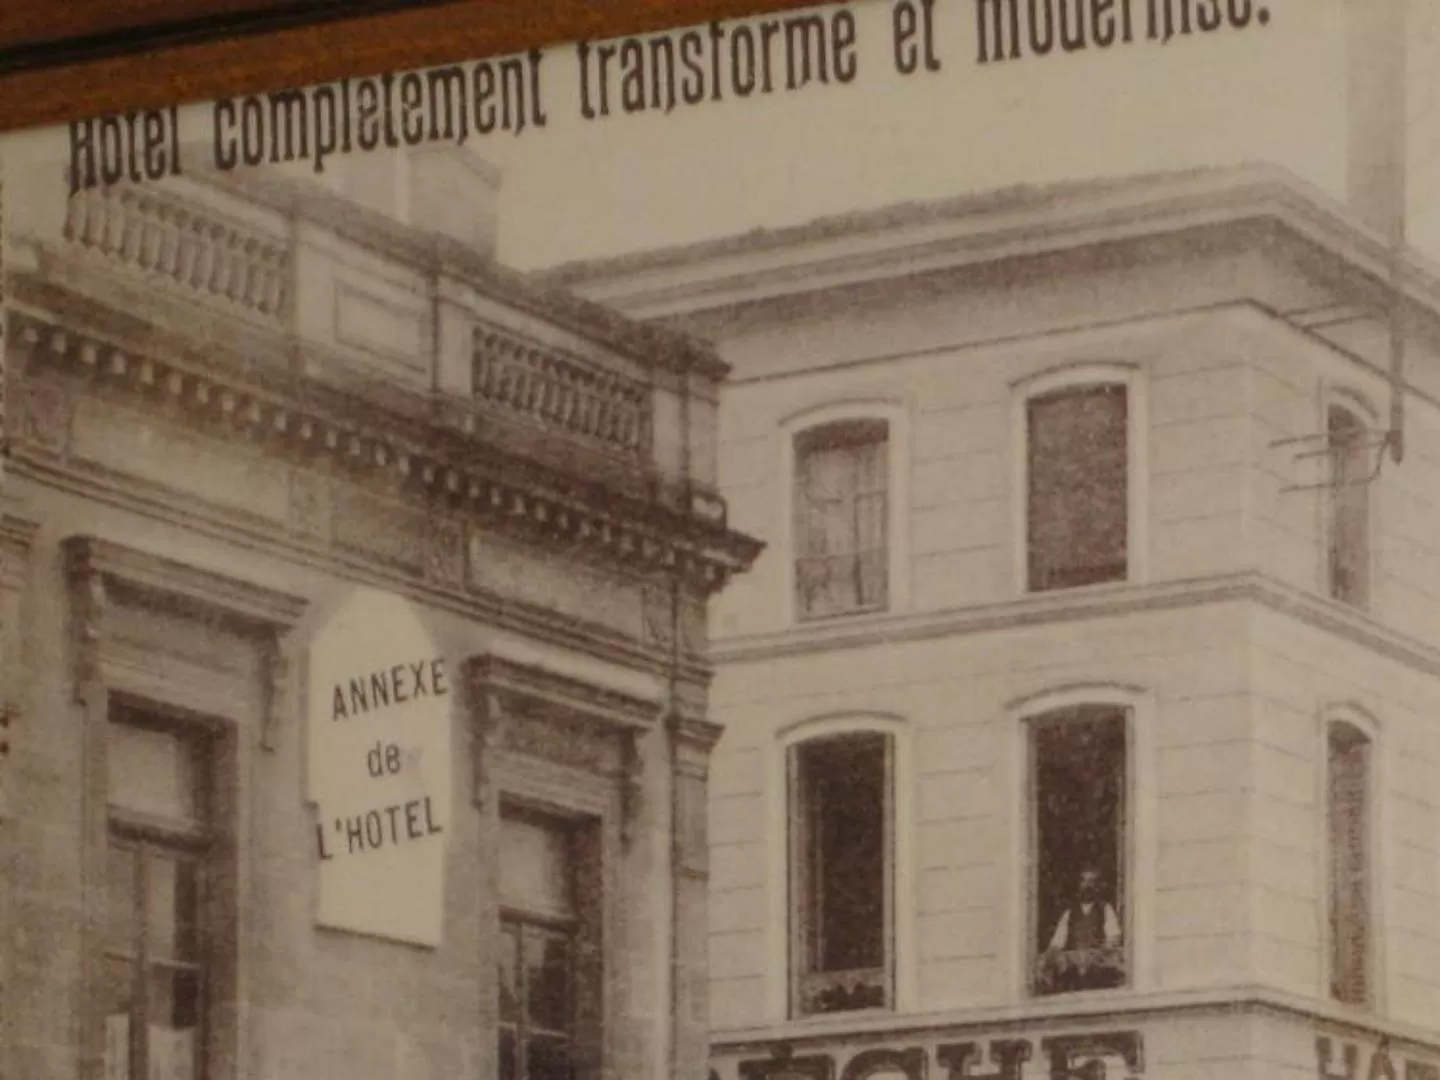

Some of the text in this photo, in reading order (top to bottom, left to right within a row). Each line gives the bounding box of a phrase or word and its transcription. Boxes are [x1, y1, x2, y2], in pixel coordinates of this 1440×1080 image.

[892, 0, 941, 74] et
[331, 657, 449, 721] ANNEXE
[366, 740, 401, 777] de
[315, 796, 443, 860] L'HOTEL
